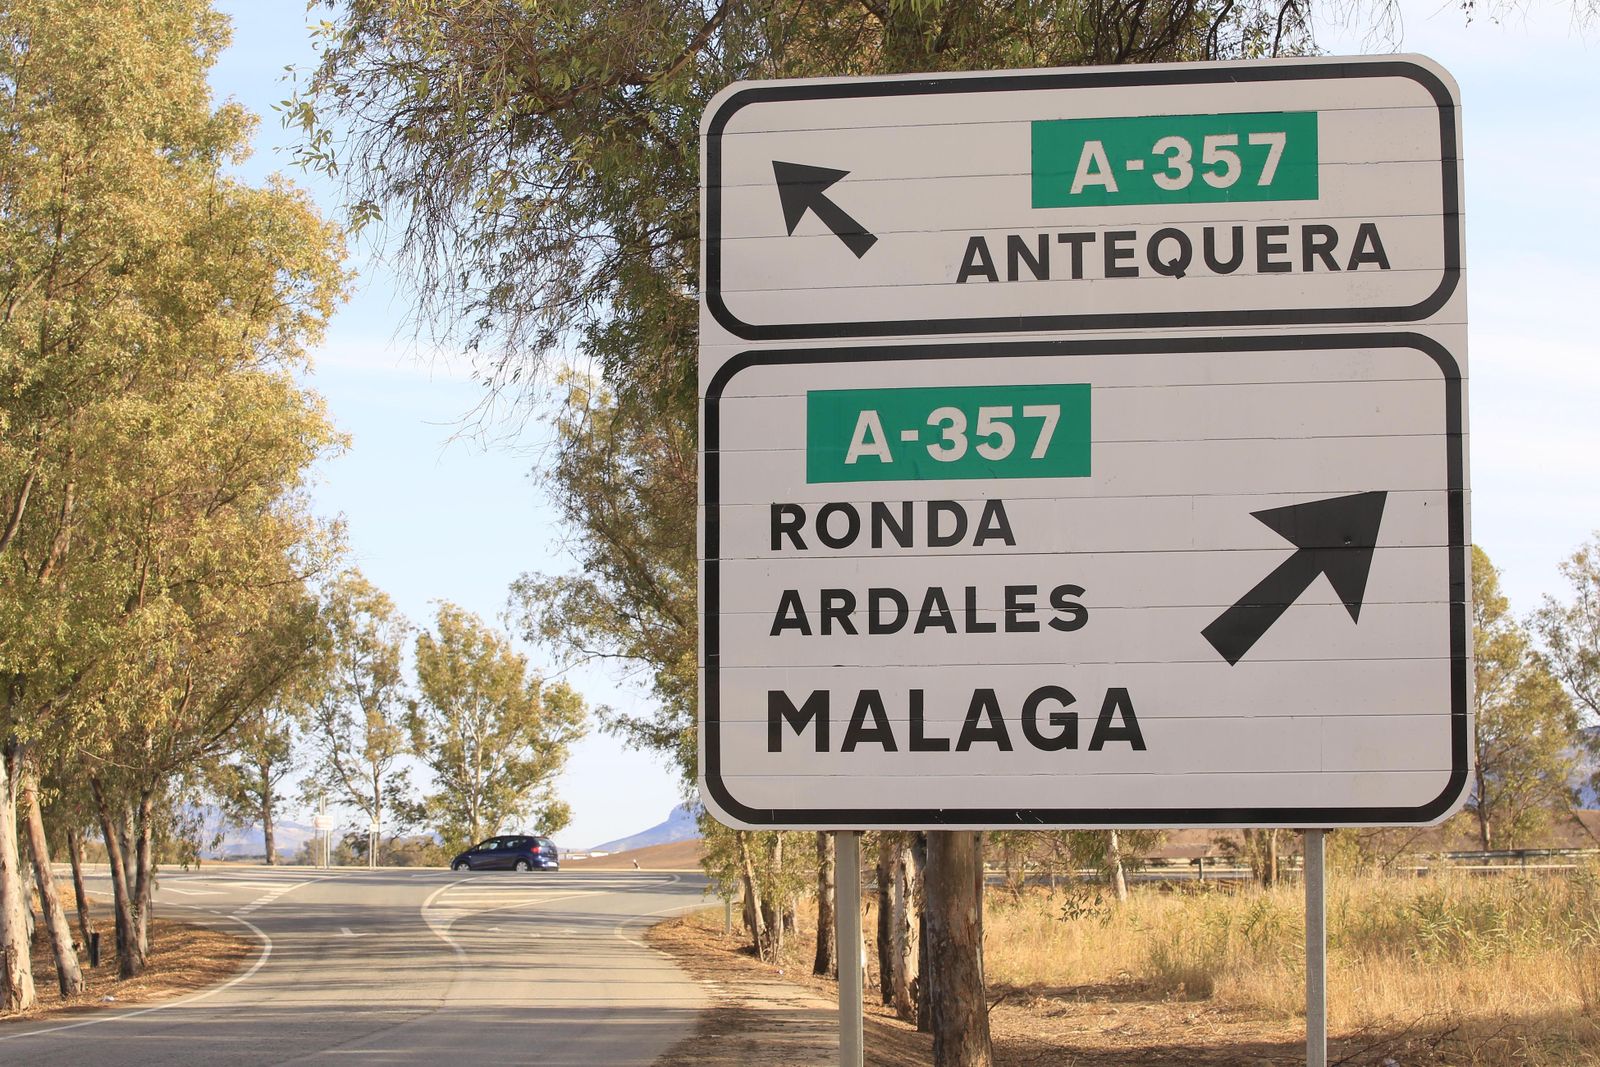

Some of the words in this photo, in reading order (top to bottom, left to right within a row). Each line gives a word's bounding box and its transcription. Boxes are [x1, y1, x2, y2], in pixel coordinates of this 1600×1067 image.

[1070, 131, 1286, 194] A-357
[956, 223, 1390, 283] ANTEQUERA
[844, 404, 1061, 464] A-357
[771, 499, 1016, 550] RONDA
[770, 584, 1089, 637] ARDALES
[768, 685, 1147, 753] MALAGA
